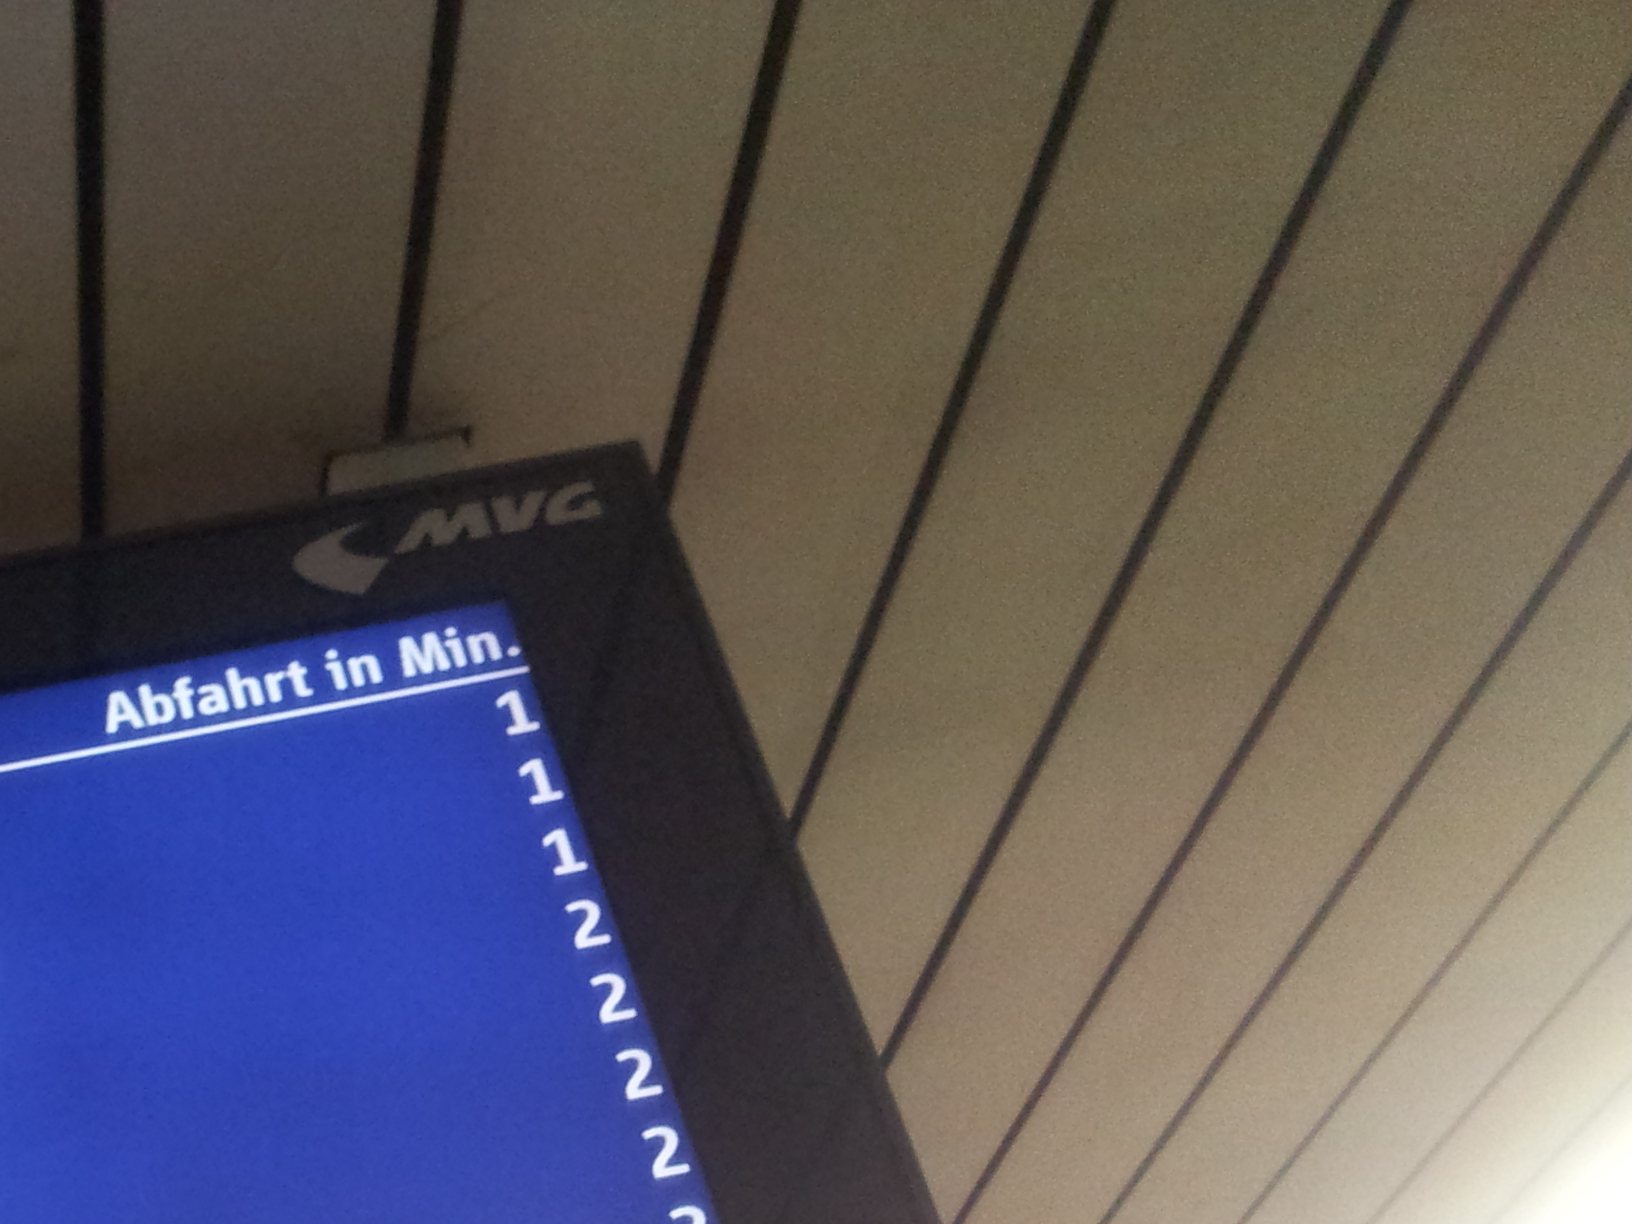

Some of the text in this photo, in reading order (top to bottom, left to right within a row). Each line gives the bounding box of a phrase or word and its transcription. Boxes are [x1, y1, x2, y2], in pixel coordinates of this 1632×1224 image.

[393, 481, 602, 553] MVG
[105, 661, 313, 734] Abfahrt
[325, 649, 382, 691] in
[398, 627, 522, 678] Min.
[496, 690, 540, 735] 1
[519, 758, 564, 805] 1
[542, 828, 588, 875] 1
[565, 900, 611, 949] 2
[590, 973, 637, 1024] 2
[615, 1048, 662, 1100] 2
[641, 1126, 690, 1178] 2
